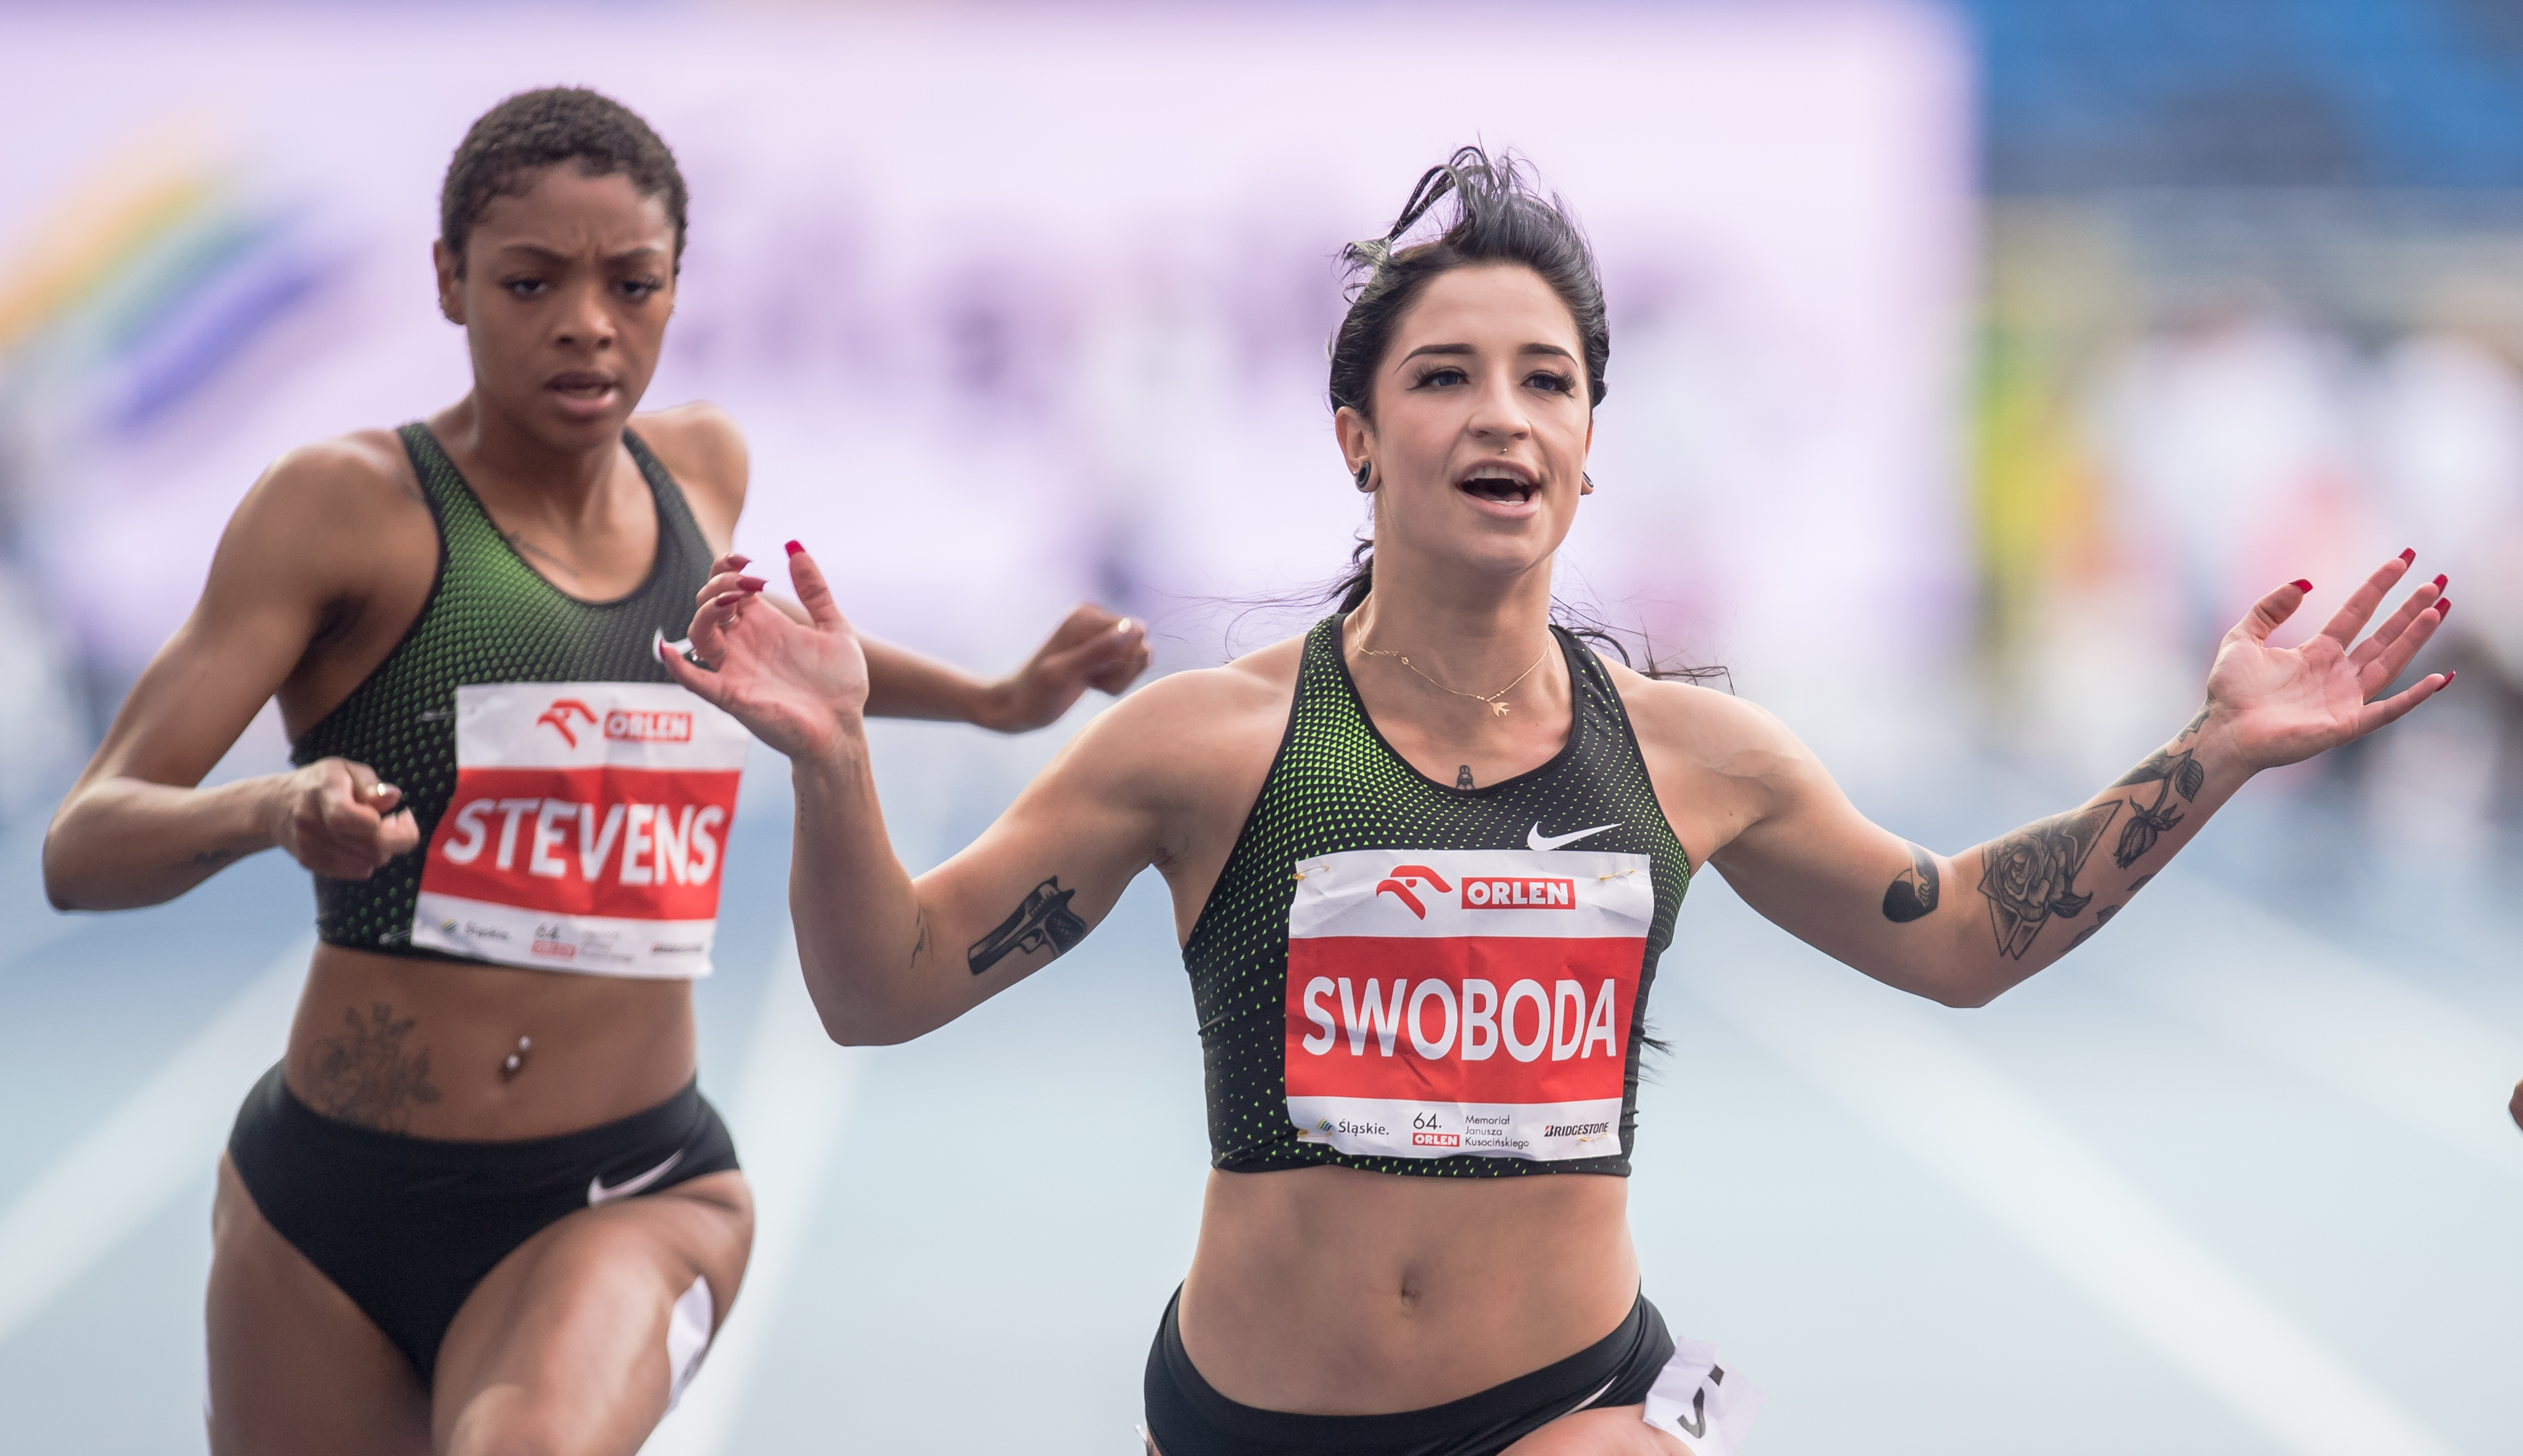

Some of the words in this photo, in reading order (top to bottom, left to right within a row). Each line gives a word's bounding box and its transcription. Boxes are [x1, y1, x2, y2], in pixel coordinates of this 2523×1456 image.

[607, 714, 687, 738] ORLEN
[442, 798, 726, 886] STEVENS
[1467, 881, 1570, 905] ORLEN
[1302, 976, 1617, 1062] SWOBODA
[1338, 1119, 1389, 1136] Śląskie.
[1413, 1112, 1442, 1129] 64.
[1465, 1115, 1510, 1125] Memoriał
[1465, 1126, 1502, 1136] Janusza
[1544, 1121, 1609, 1137] BRIDGESTONE
[1414, 1133, 1458, 1146] ORLEN
[1465, 1137, 1530, 1150] Kusocińskiego
